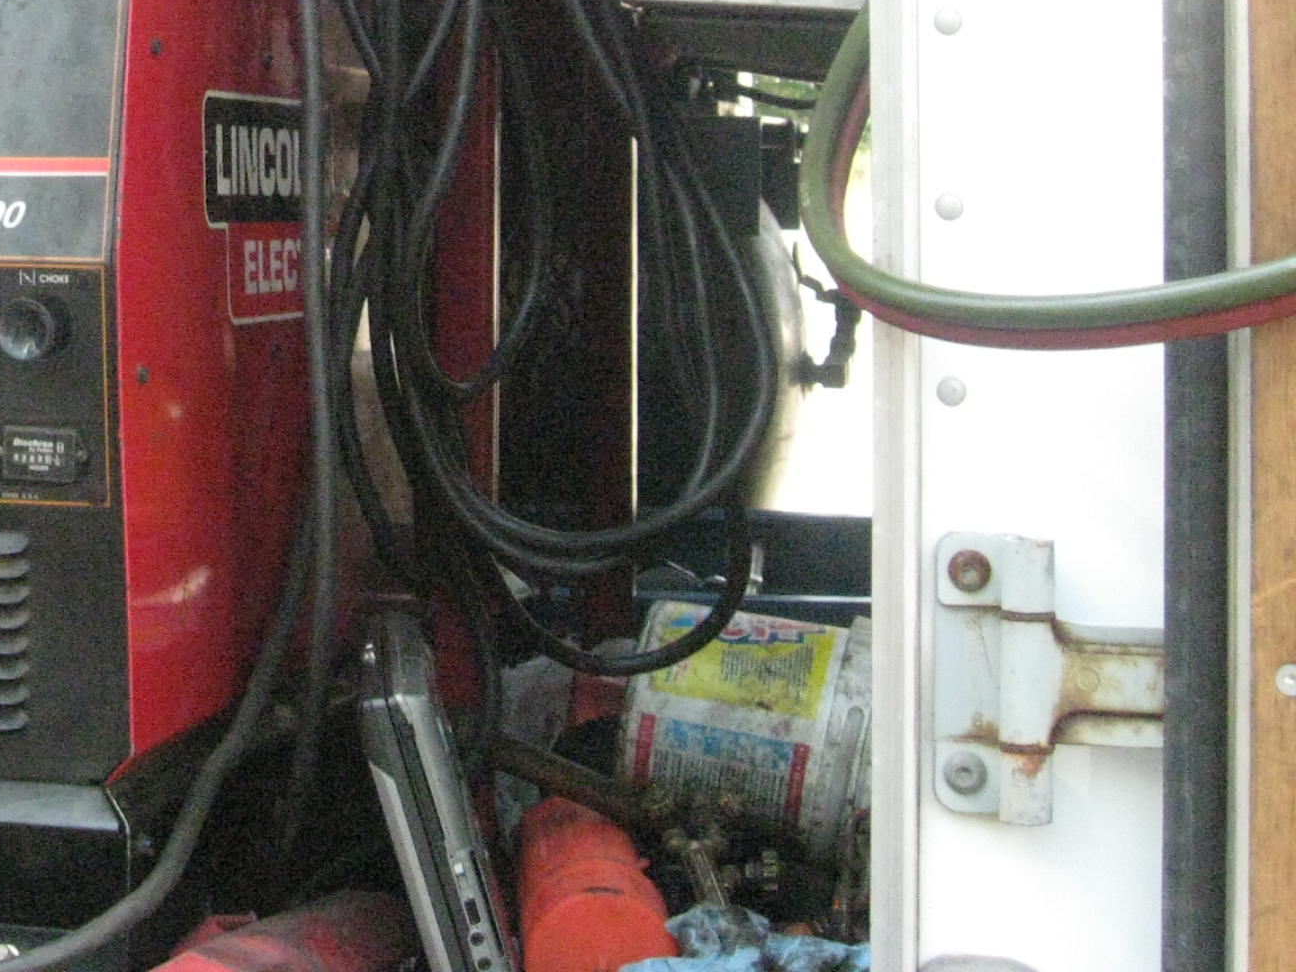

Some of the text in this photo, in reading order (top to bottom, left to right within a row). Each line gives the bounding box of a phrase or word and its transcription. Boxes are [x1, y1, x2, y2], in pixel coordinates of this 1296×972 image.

[216, 124, 302, 196] LINCOL
[39, 274, 69, 284] CHOKE
[244, 238, 302, 295] ELEC
